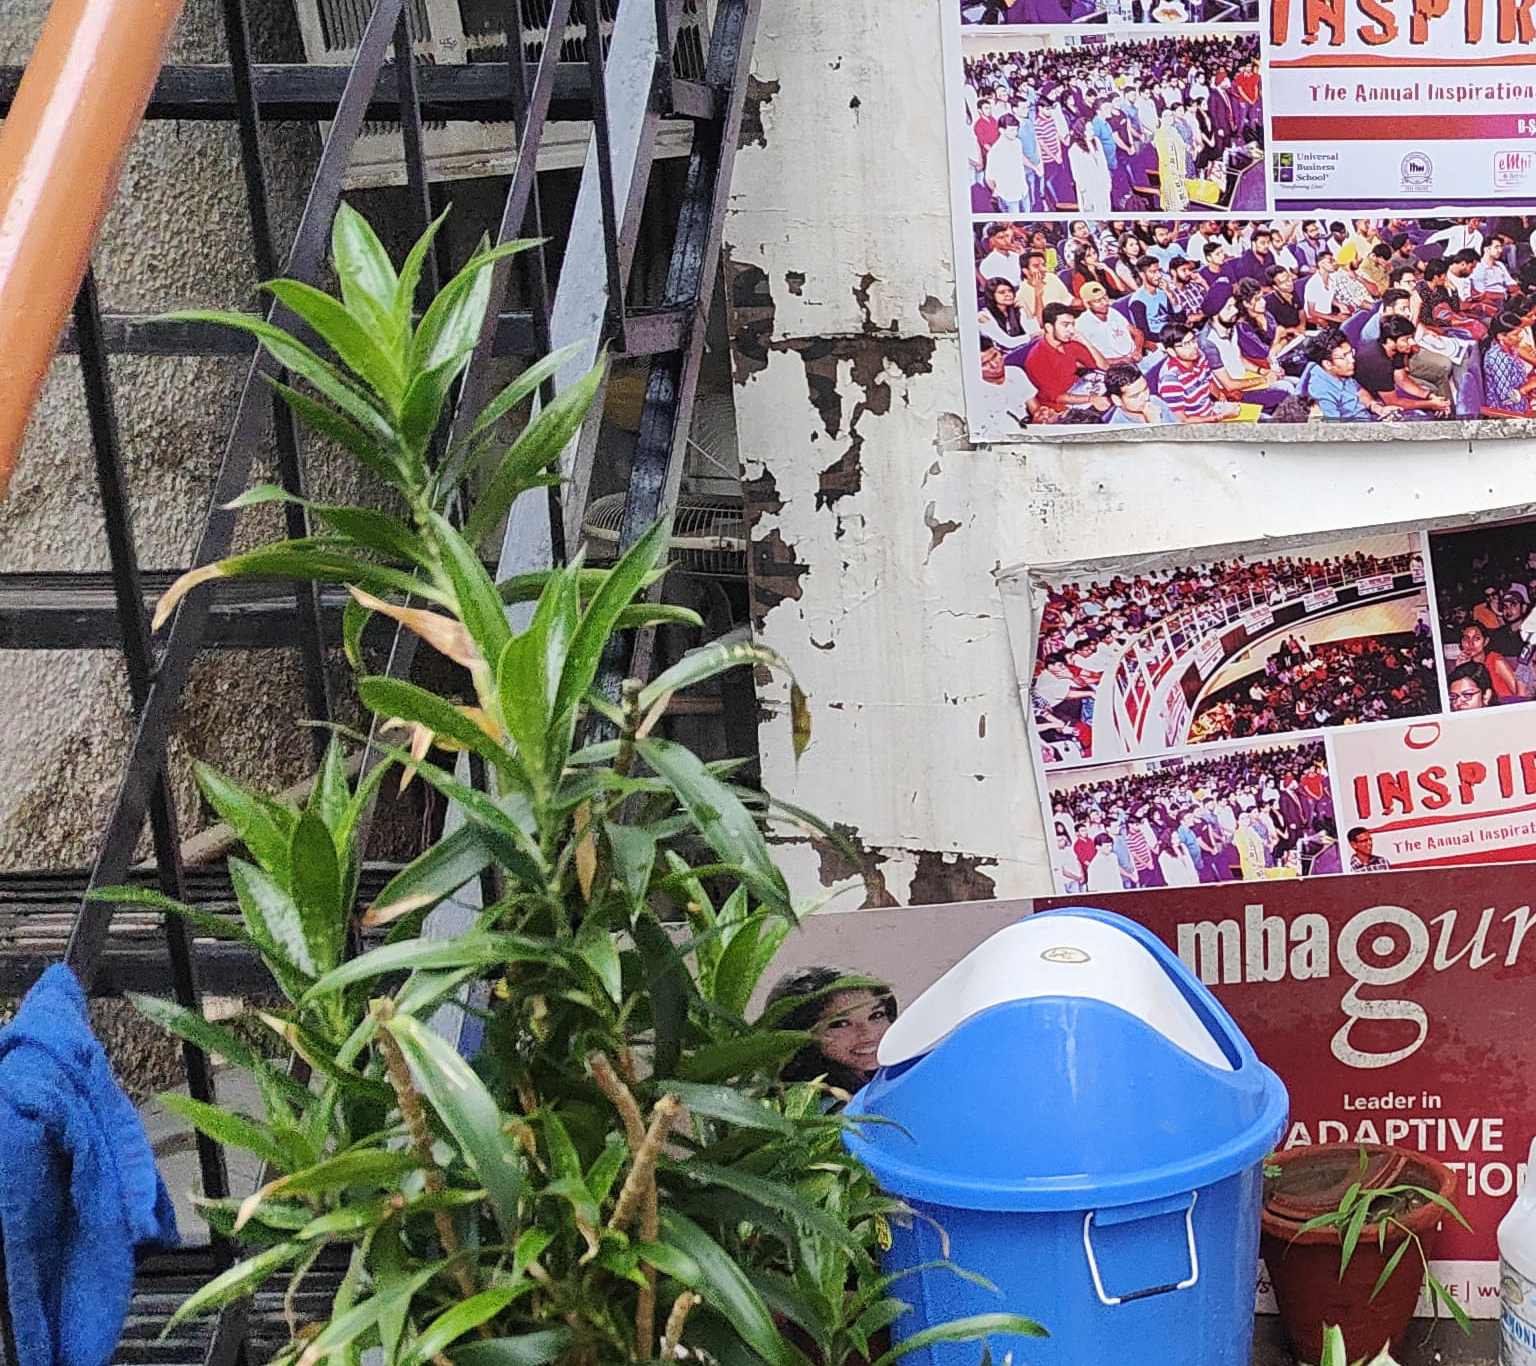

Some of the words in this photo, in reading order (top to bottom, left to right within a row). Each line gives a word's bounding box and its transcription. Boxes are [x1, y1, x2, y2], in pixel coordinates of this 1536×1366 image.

[1309, 84, 1347, 102] The
[1354, 82, 1420, 102] Annual
[1297, 152, 1339, 161] Universal
[1297, 163, 1336, 171] Business
[1393, 837, 1422, 854] The
[1427, 831, 1475, 850] Annual
[1343, 1091, 1417, 1111] Leader
[1422, 1090, 1442, 1109] in
[1284, 1118, 1504, 1152] ADAPTIVE
